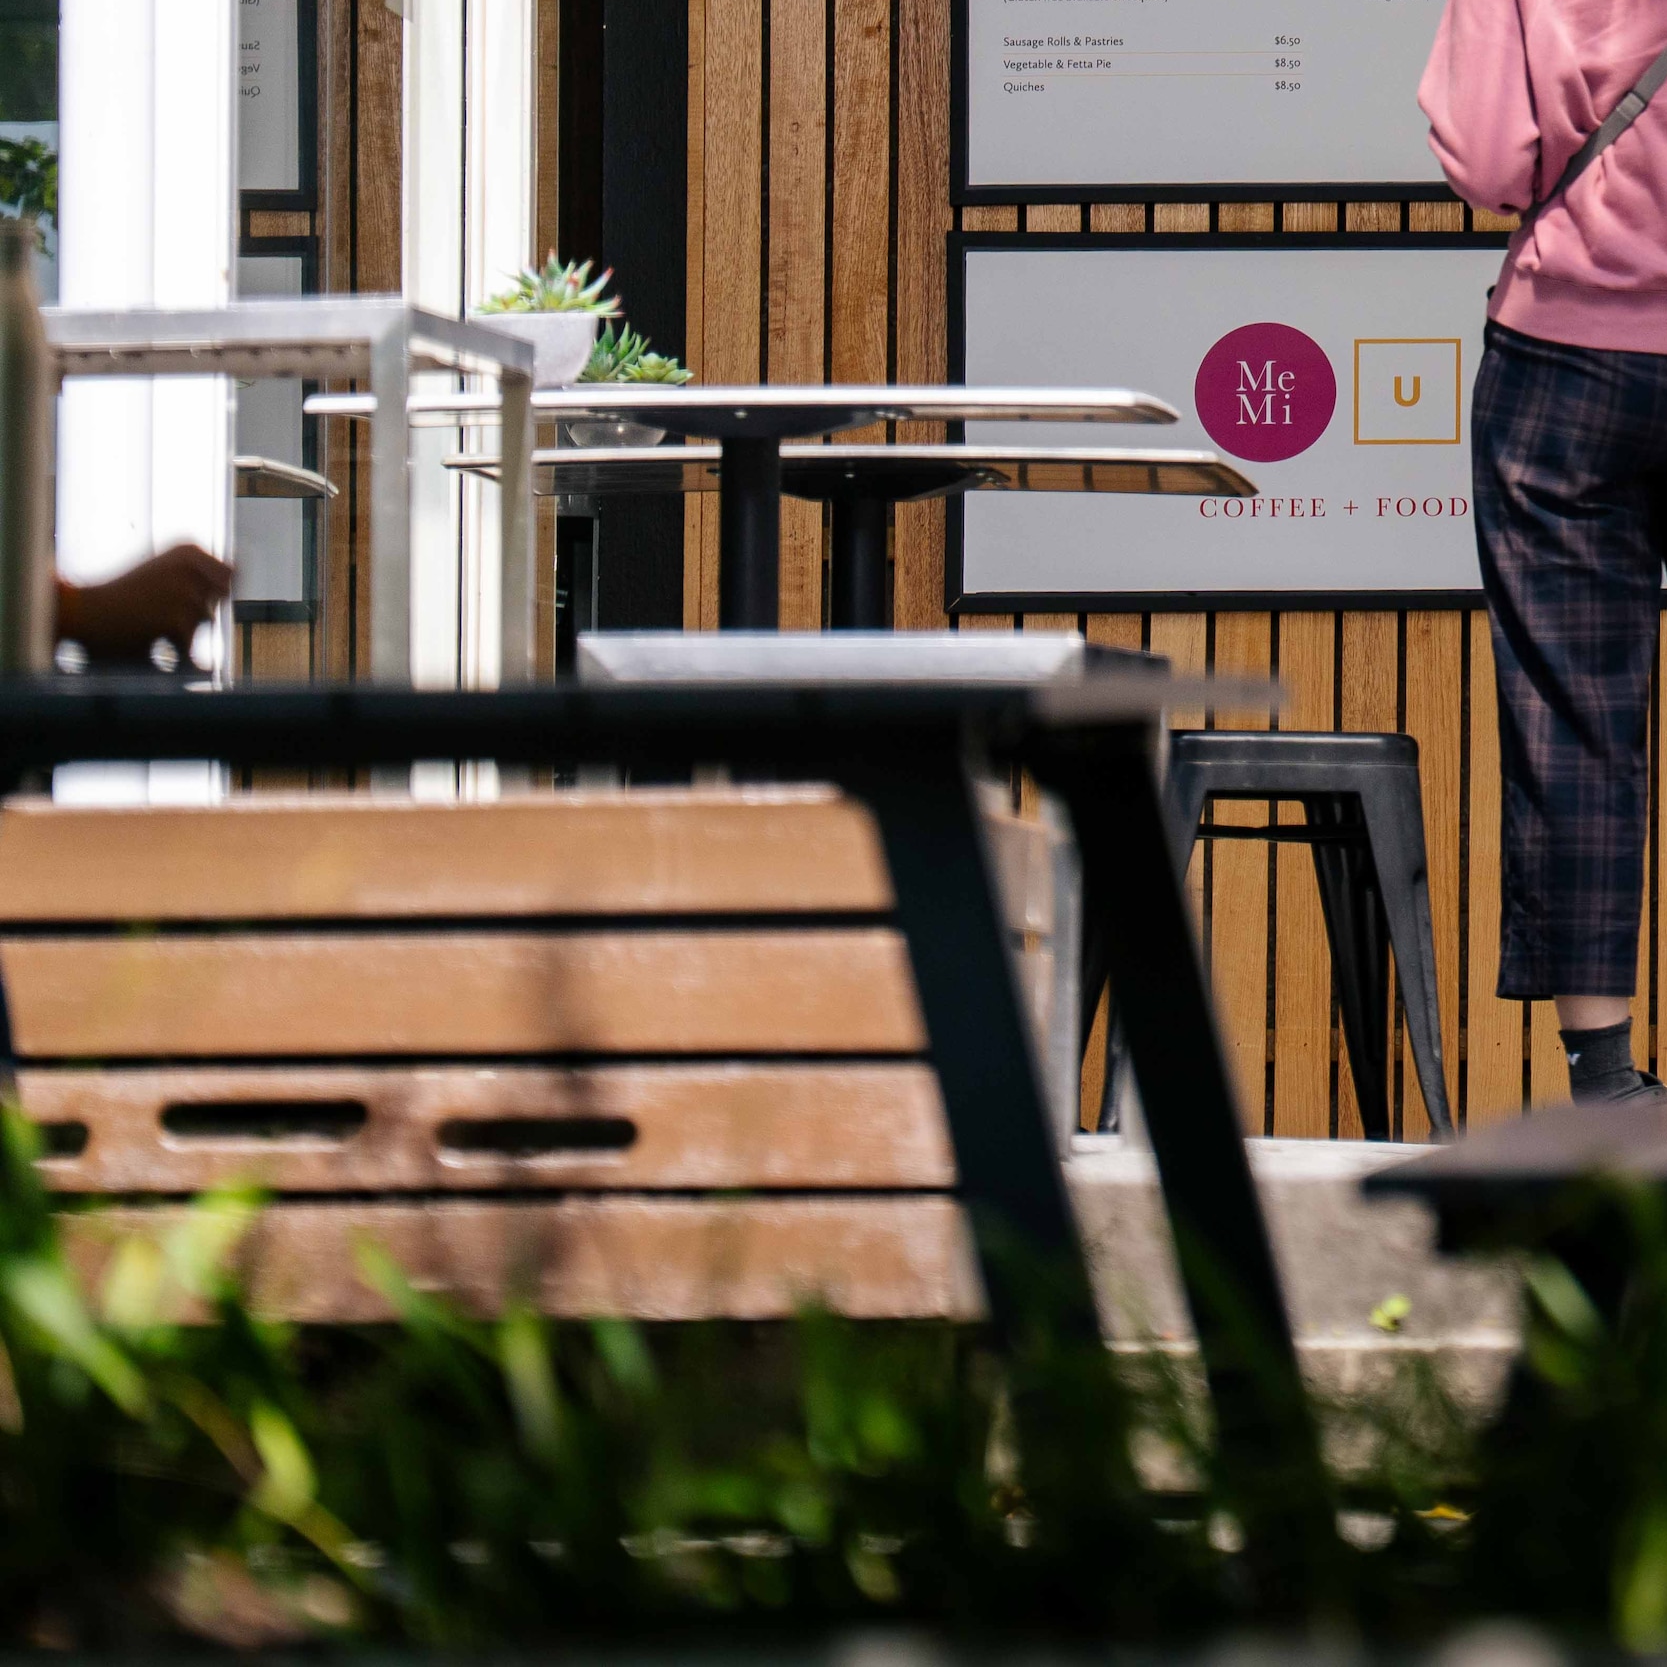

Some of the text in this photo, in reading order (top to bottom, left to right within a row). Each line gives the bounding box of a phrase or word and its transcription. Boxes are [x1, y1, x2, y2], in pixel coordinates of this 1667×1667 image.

[1003, 36, 1124, 49] Sausage Rolls Pastries
[1274, 35, 1301, 47] $6.50
[1003, 59, 1111, 72] Vegetable Fetta Pie
[1275, 57, 1301, 70] $8.50
[1003, 81, 1045, 94] Quiches
[1275, 80, 1301, 92] $8.50
[1236, 361, 1295, 392] Me
[1394, 376, 1421, 407] U
[1236, 394, 1293, 425] Mi
[1200, 497, 1468, 518] COFFEE + FOOD
